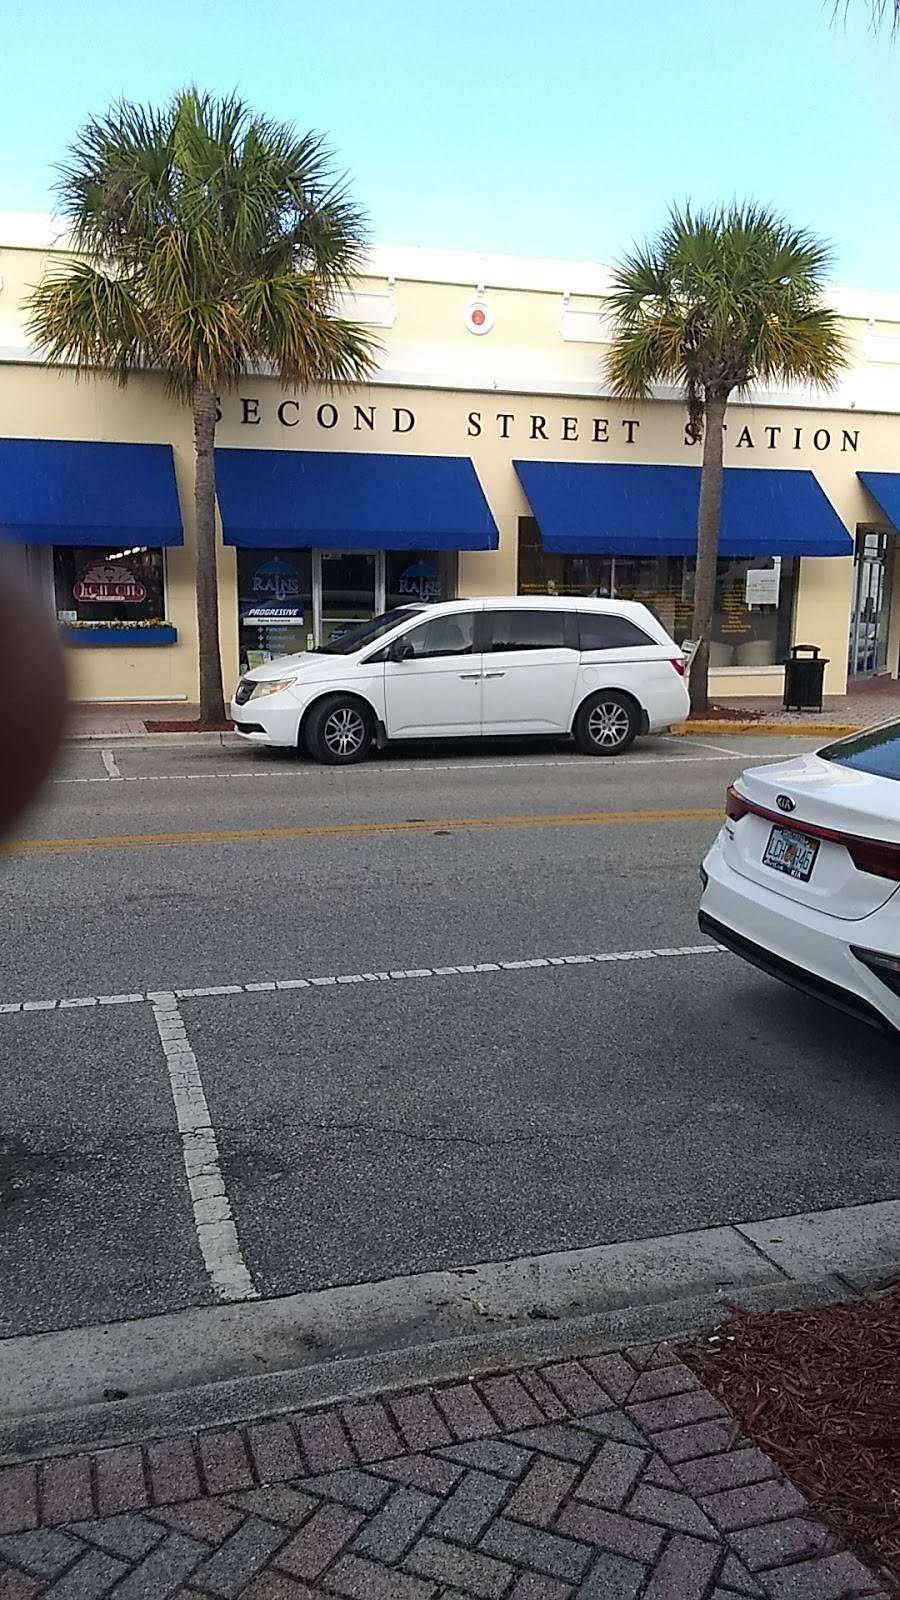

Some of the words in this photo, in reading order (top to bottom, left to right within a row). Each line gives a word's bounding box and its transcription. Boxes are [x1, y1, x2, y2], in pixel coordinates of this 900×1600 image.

[467, 412, 640, 443] STREET
[684, 422, 861, 452] SATION
[248, 608, 298, 616] PROGRESSIVE
[778, 797, 792, 810] KIA
